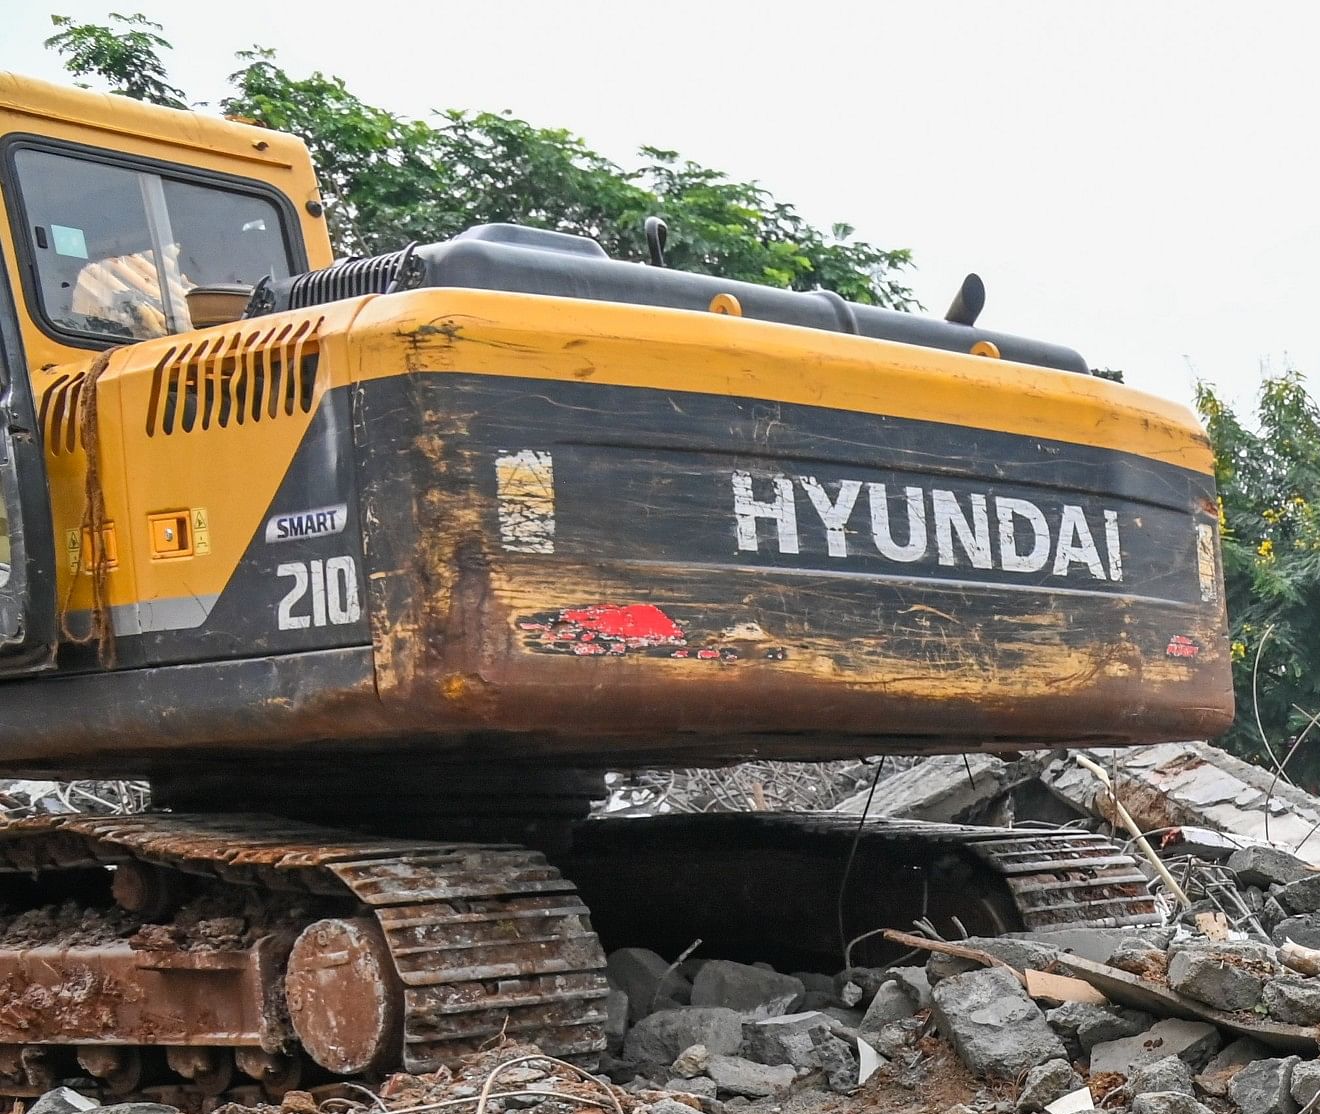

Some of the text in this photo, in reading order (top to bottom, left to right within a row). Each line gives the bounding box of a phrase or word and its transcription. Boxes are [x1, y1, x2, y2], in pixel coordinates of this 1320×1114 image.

[276, 510, 337, 539] SMART
[731, 469, 1124, 582] HYUNDAI
[276, 555, 361, 631] 210
